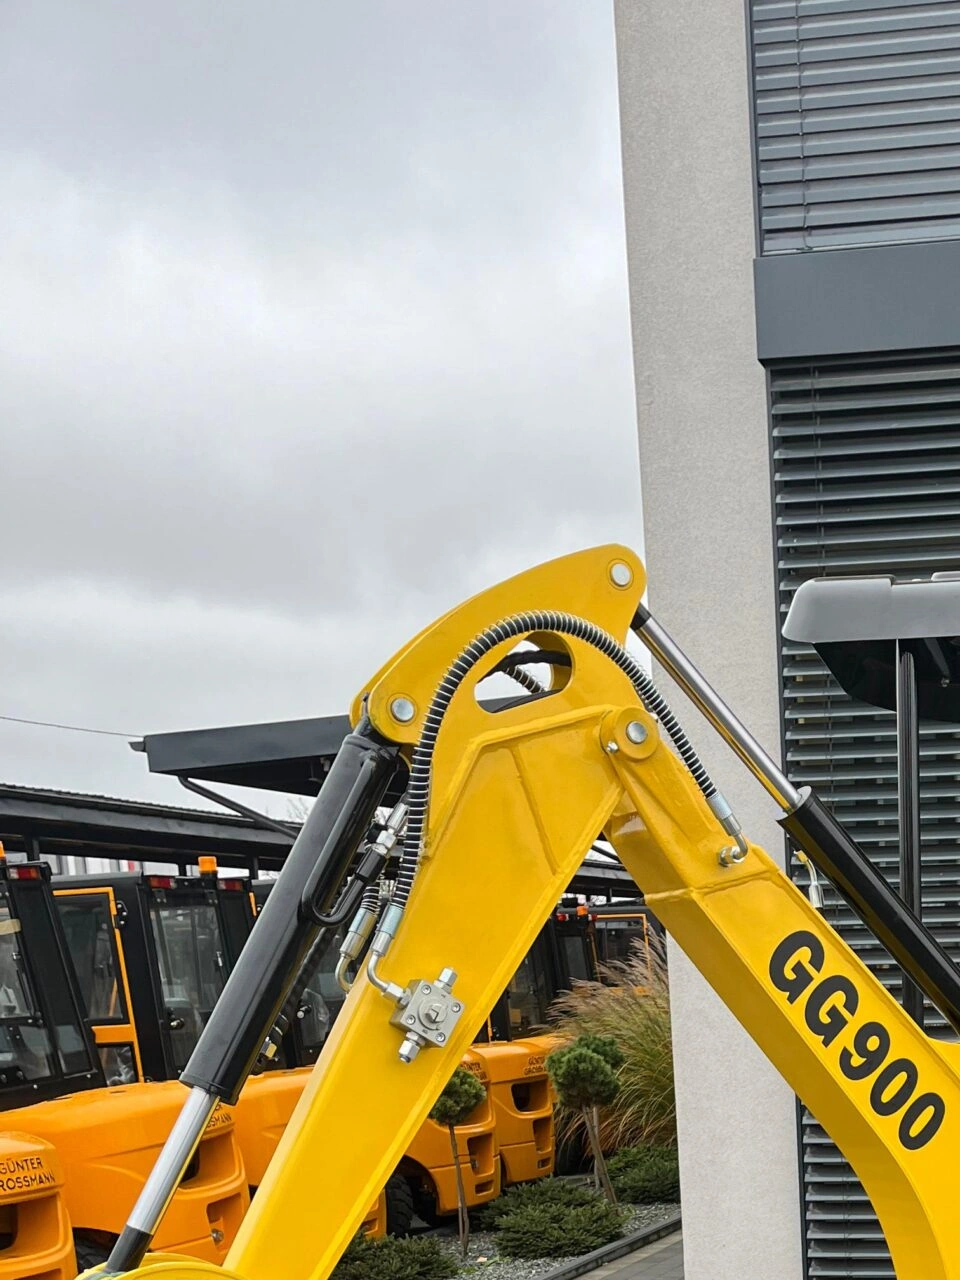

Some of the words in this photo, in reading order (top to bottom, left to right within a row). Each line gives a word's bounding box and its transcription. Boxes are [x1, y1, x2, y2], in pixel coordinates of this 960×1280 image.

[768, 930, 946, 1151] GG900
[0, 1157, 43, 1175] GÜNTER
[0, 1170, 56, 1192] ROSSMANN
